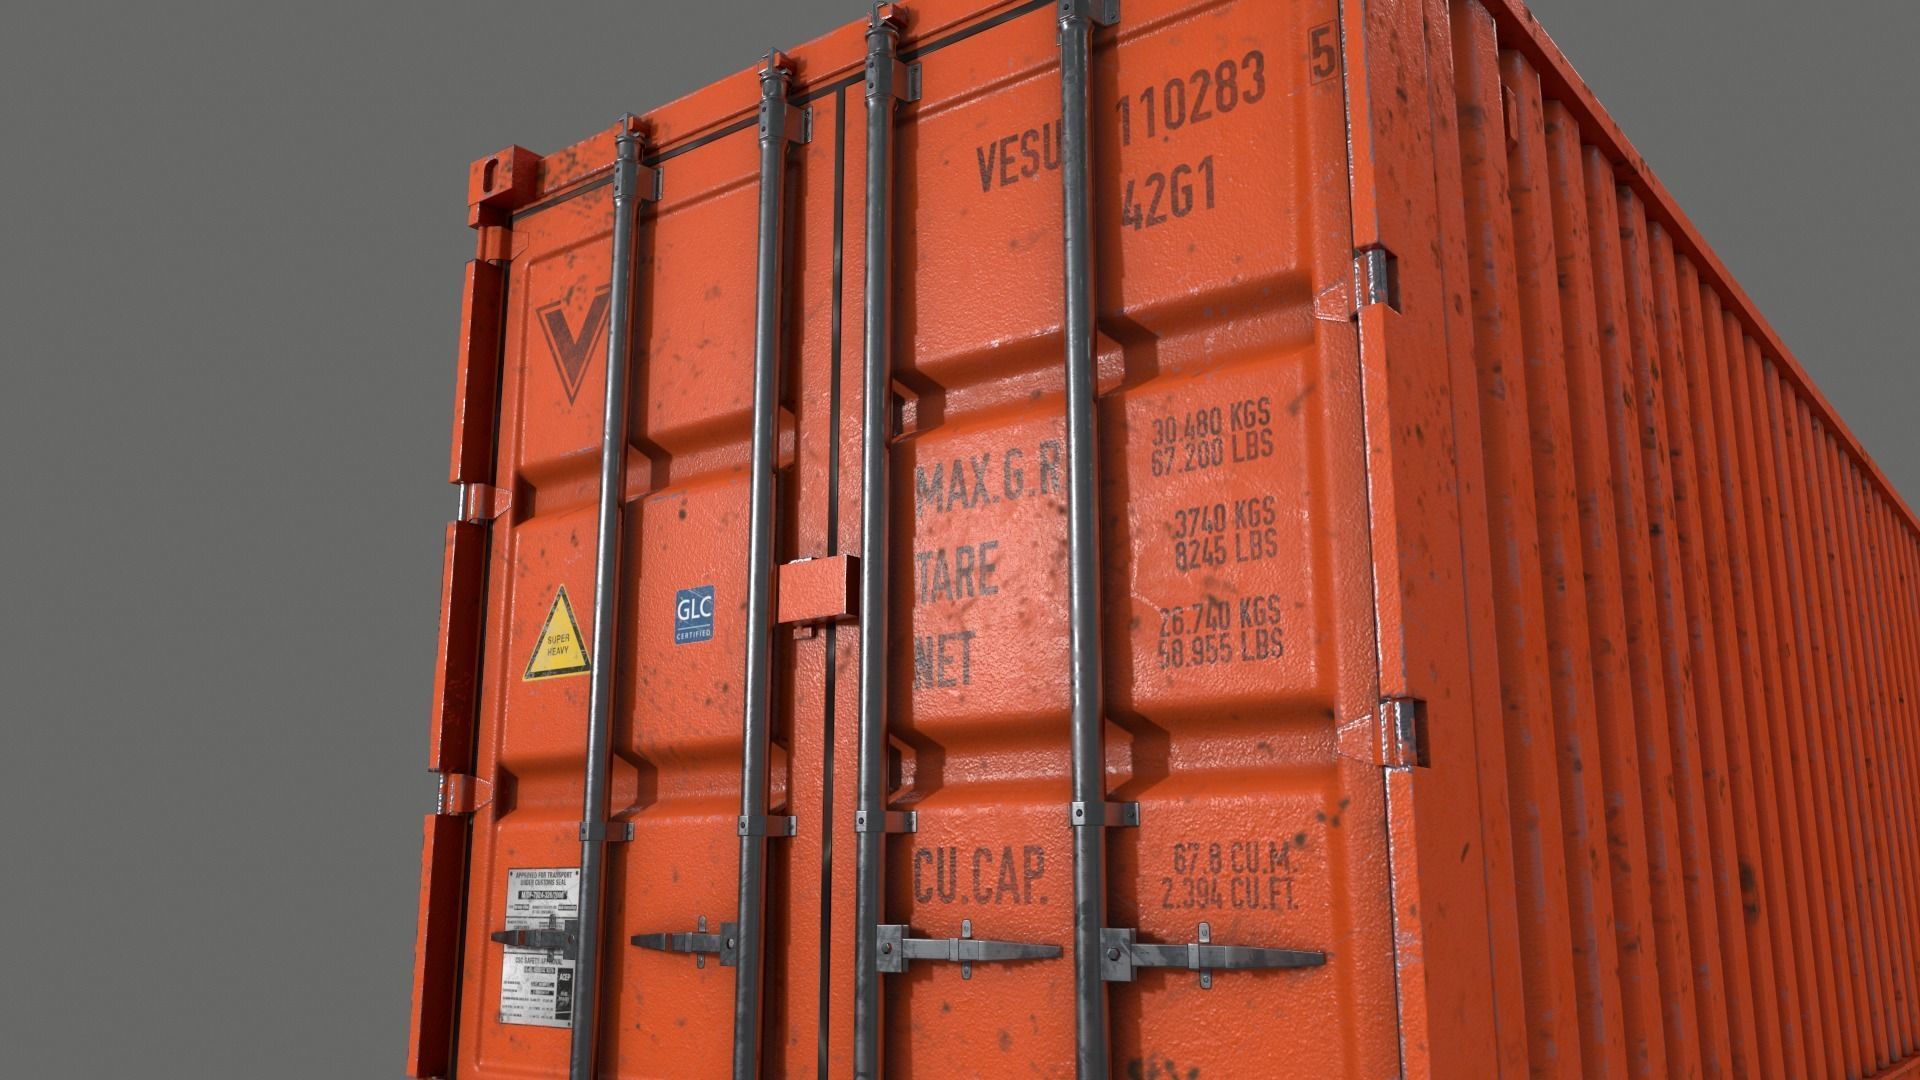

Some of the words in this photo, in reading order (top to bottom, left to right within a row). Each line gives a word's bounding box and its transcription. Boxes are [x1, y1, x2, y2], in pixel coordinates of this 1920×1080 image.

[976, 119, 1062, 193] VESU
[1115, 50, 1266, 147] 110283
[1311, 25, 1336, 78] 5
[1121, 155, 1215, 231] 42G1
[1152, 406, 1222, 446] 30.480
[1230, 396, 1271, 431] KGS
[1151, 437, 1223, 477] 67.200
[1231, 428, 1274, 463] LBS
[1173, 503, 1226, 539] 3740
[1235, 496, 1276, 529] KGS
[1175, 535, 1227, 571] 8245
[1236, 528, 1278, 563] LBS
[917, 540, 998, 604] TARE
[677, 595, 711, 620] GLC
[1160, 599, 1231, 637] 26.740
[1240, 594, 1281, 628] KGS
[547, 633, 570, 644] SUPER
[547, 646, 569, 656] HEAVY
[676, 629, 711, 640] CERTIFIED
[1158, 633, 1232, 669] 58.955
[1241, 627, 1284, 662] LBS
[914, 631, 976, 689] NET
[914, 844, 1048, 904] CU.CAP.
[1174, 843, 1222, 874] 67.8
[1231, 841, 1298, 873] CU.M.
[1162, 876, 1222, 909] 2.394
[1231, 876, 1299, 910] CU.FT.
